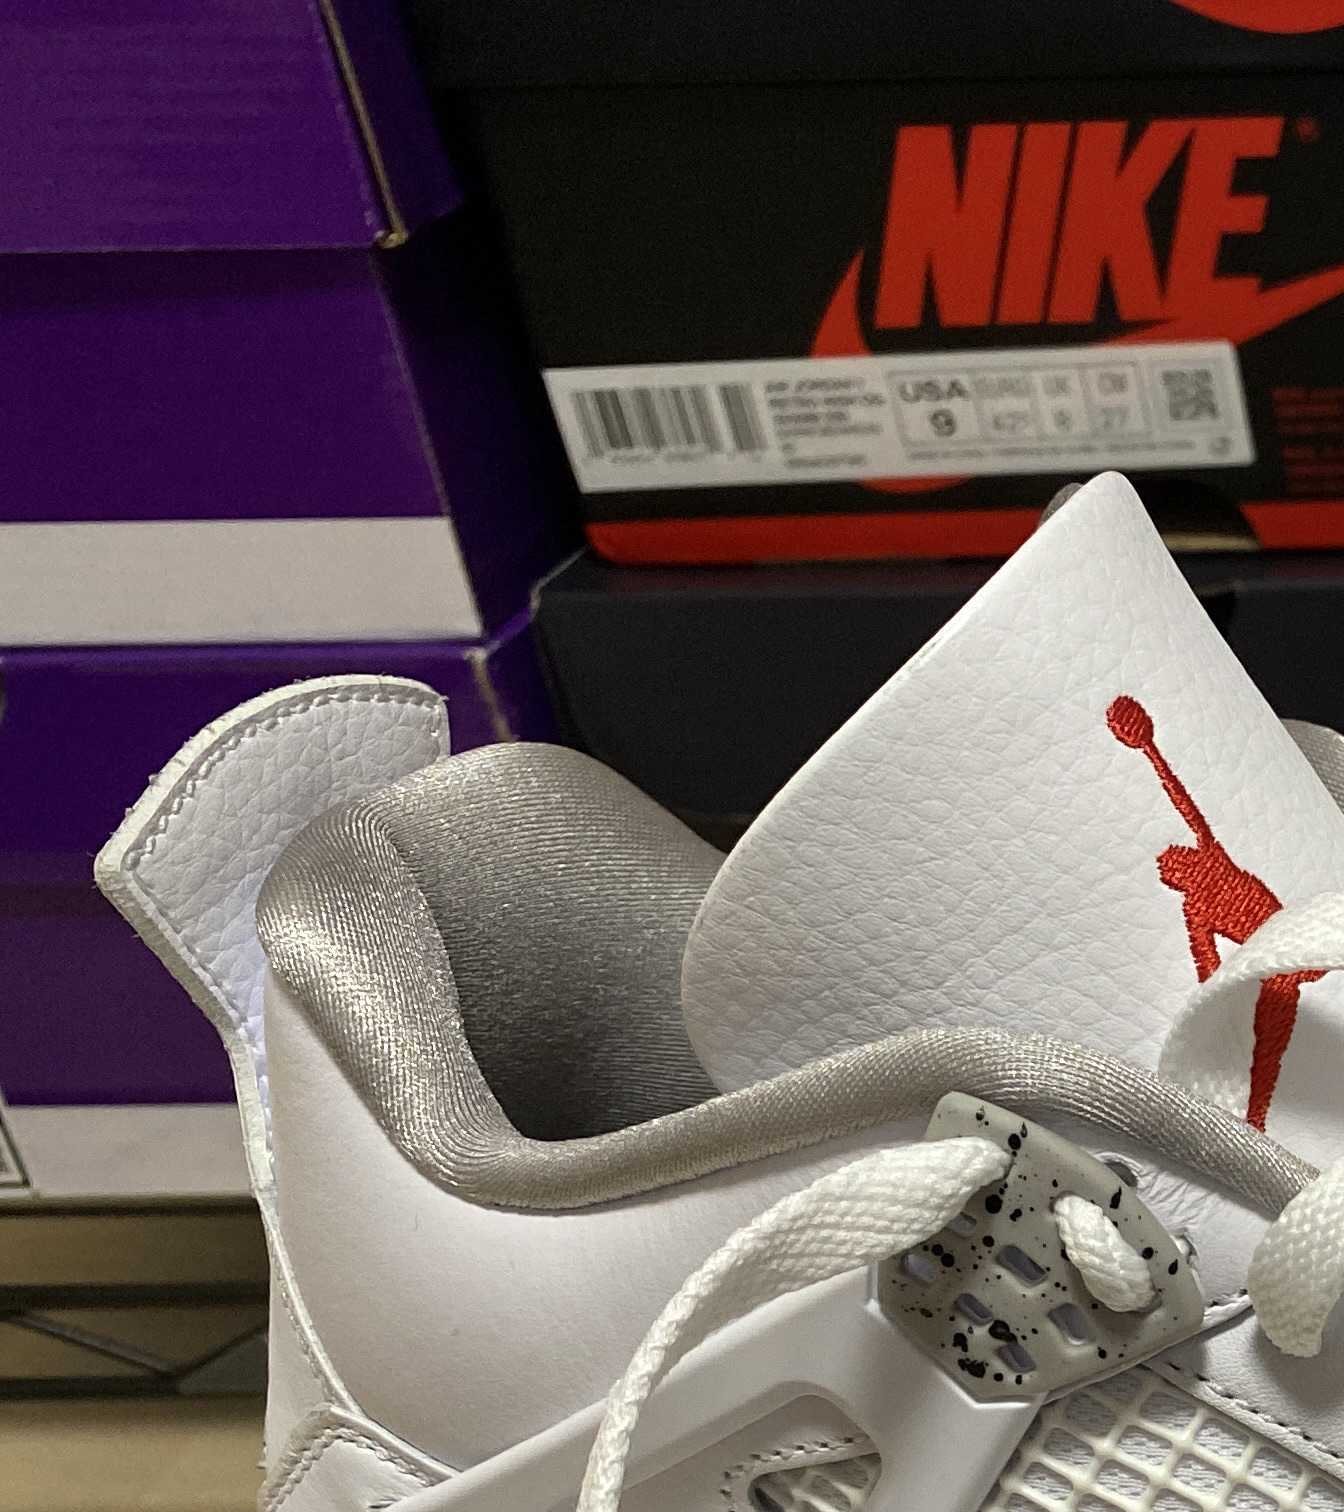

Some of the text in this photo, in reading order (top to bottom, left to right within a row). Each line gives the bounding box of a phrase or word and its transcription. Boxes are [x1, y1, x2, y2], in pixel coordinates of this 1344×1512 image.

[874, 116, 1285, 330] NIKE
[899, 377, 970, 404] USA
[929, 408, 957, 438] 9
